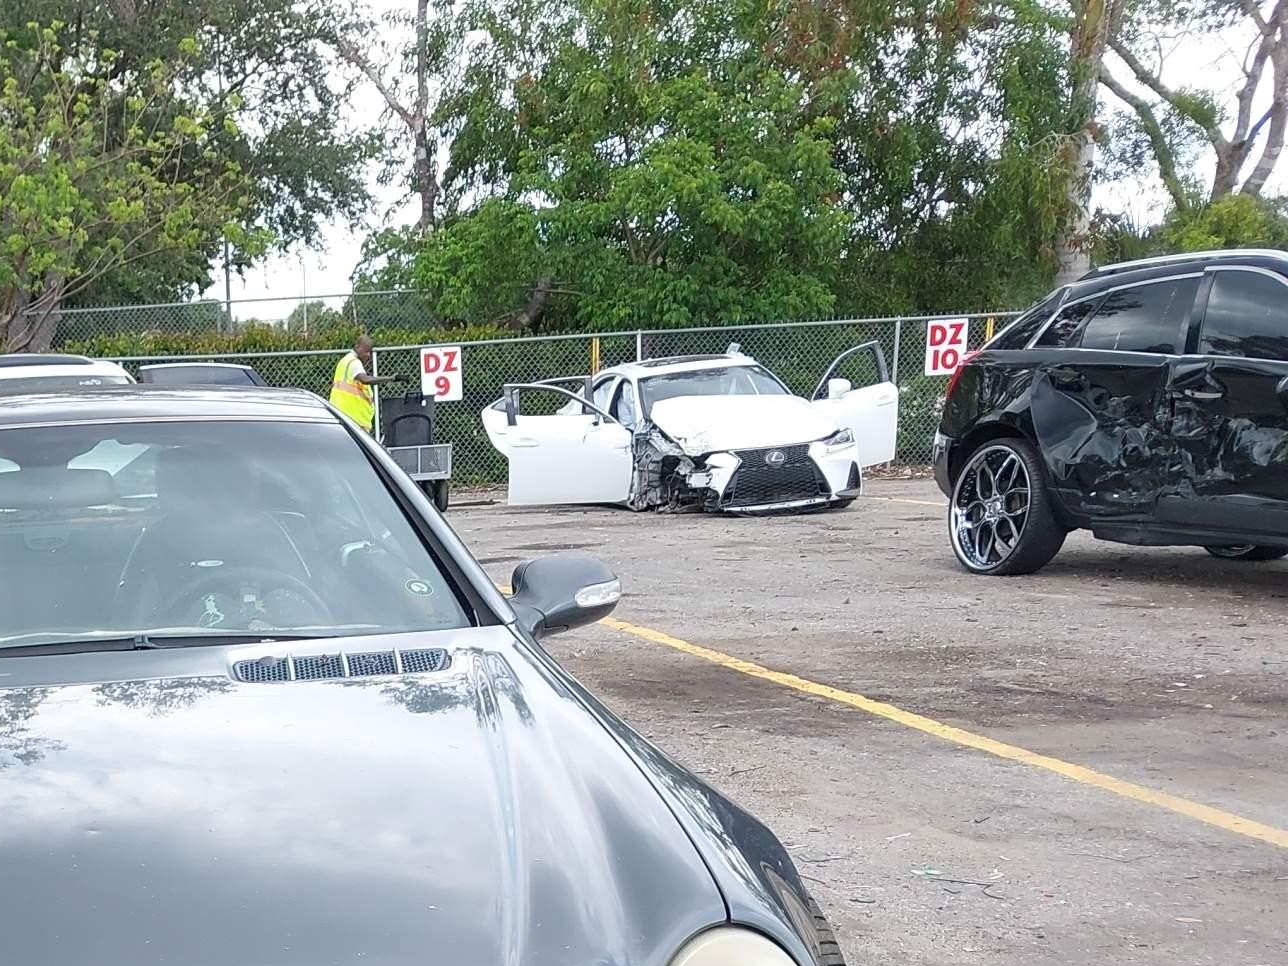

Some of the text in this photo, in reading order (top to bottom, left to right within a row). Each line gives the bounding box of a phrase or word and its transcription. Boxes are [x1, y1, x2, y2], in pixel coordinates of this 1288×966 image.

[929, 322, 965, 347] DZ
[423, 351, 459, 374] DZ
[931, 348, 959, 371] 10
[434, 376, 451, 397] 9
